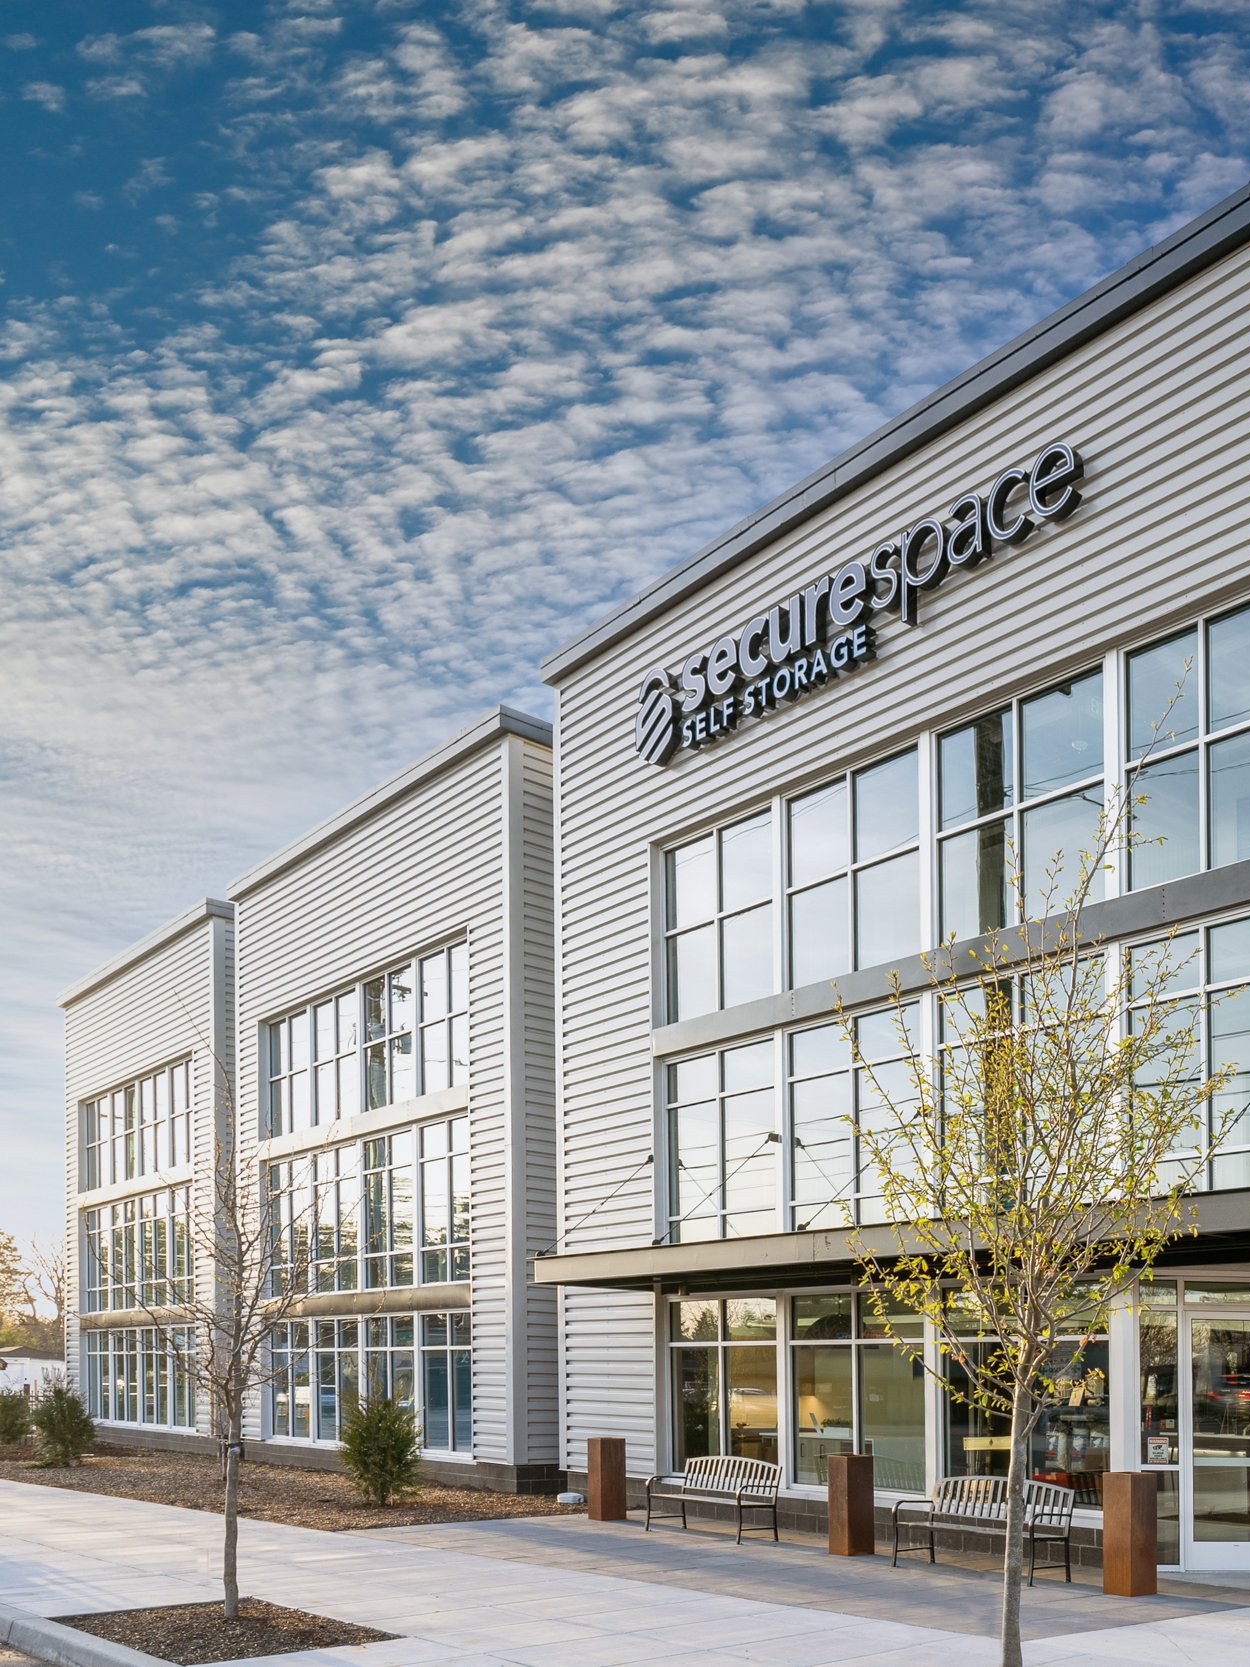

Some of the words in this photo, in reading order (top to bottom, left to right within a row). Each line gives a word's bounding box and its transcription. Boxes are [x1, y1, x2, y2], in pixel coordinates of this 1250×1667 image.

[681, 441, 1081, 713] securespace
[681, 697, 739, 748] SELF
[742, 624, 872, 715] STORAGE
